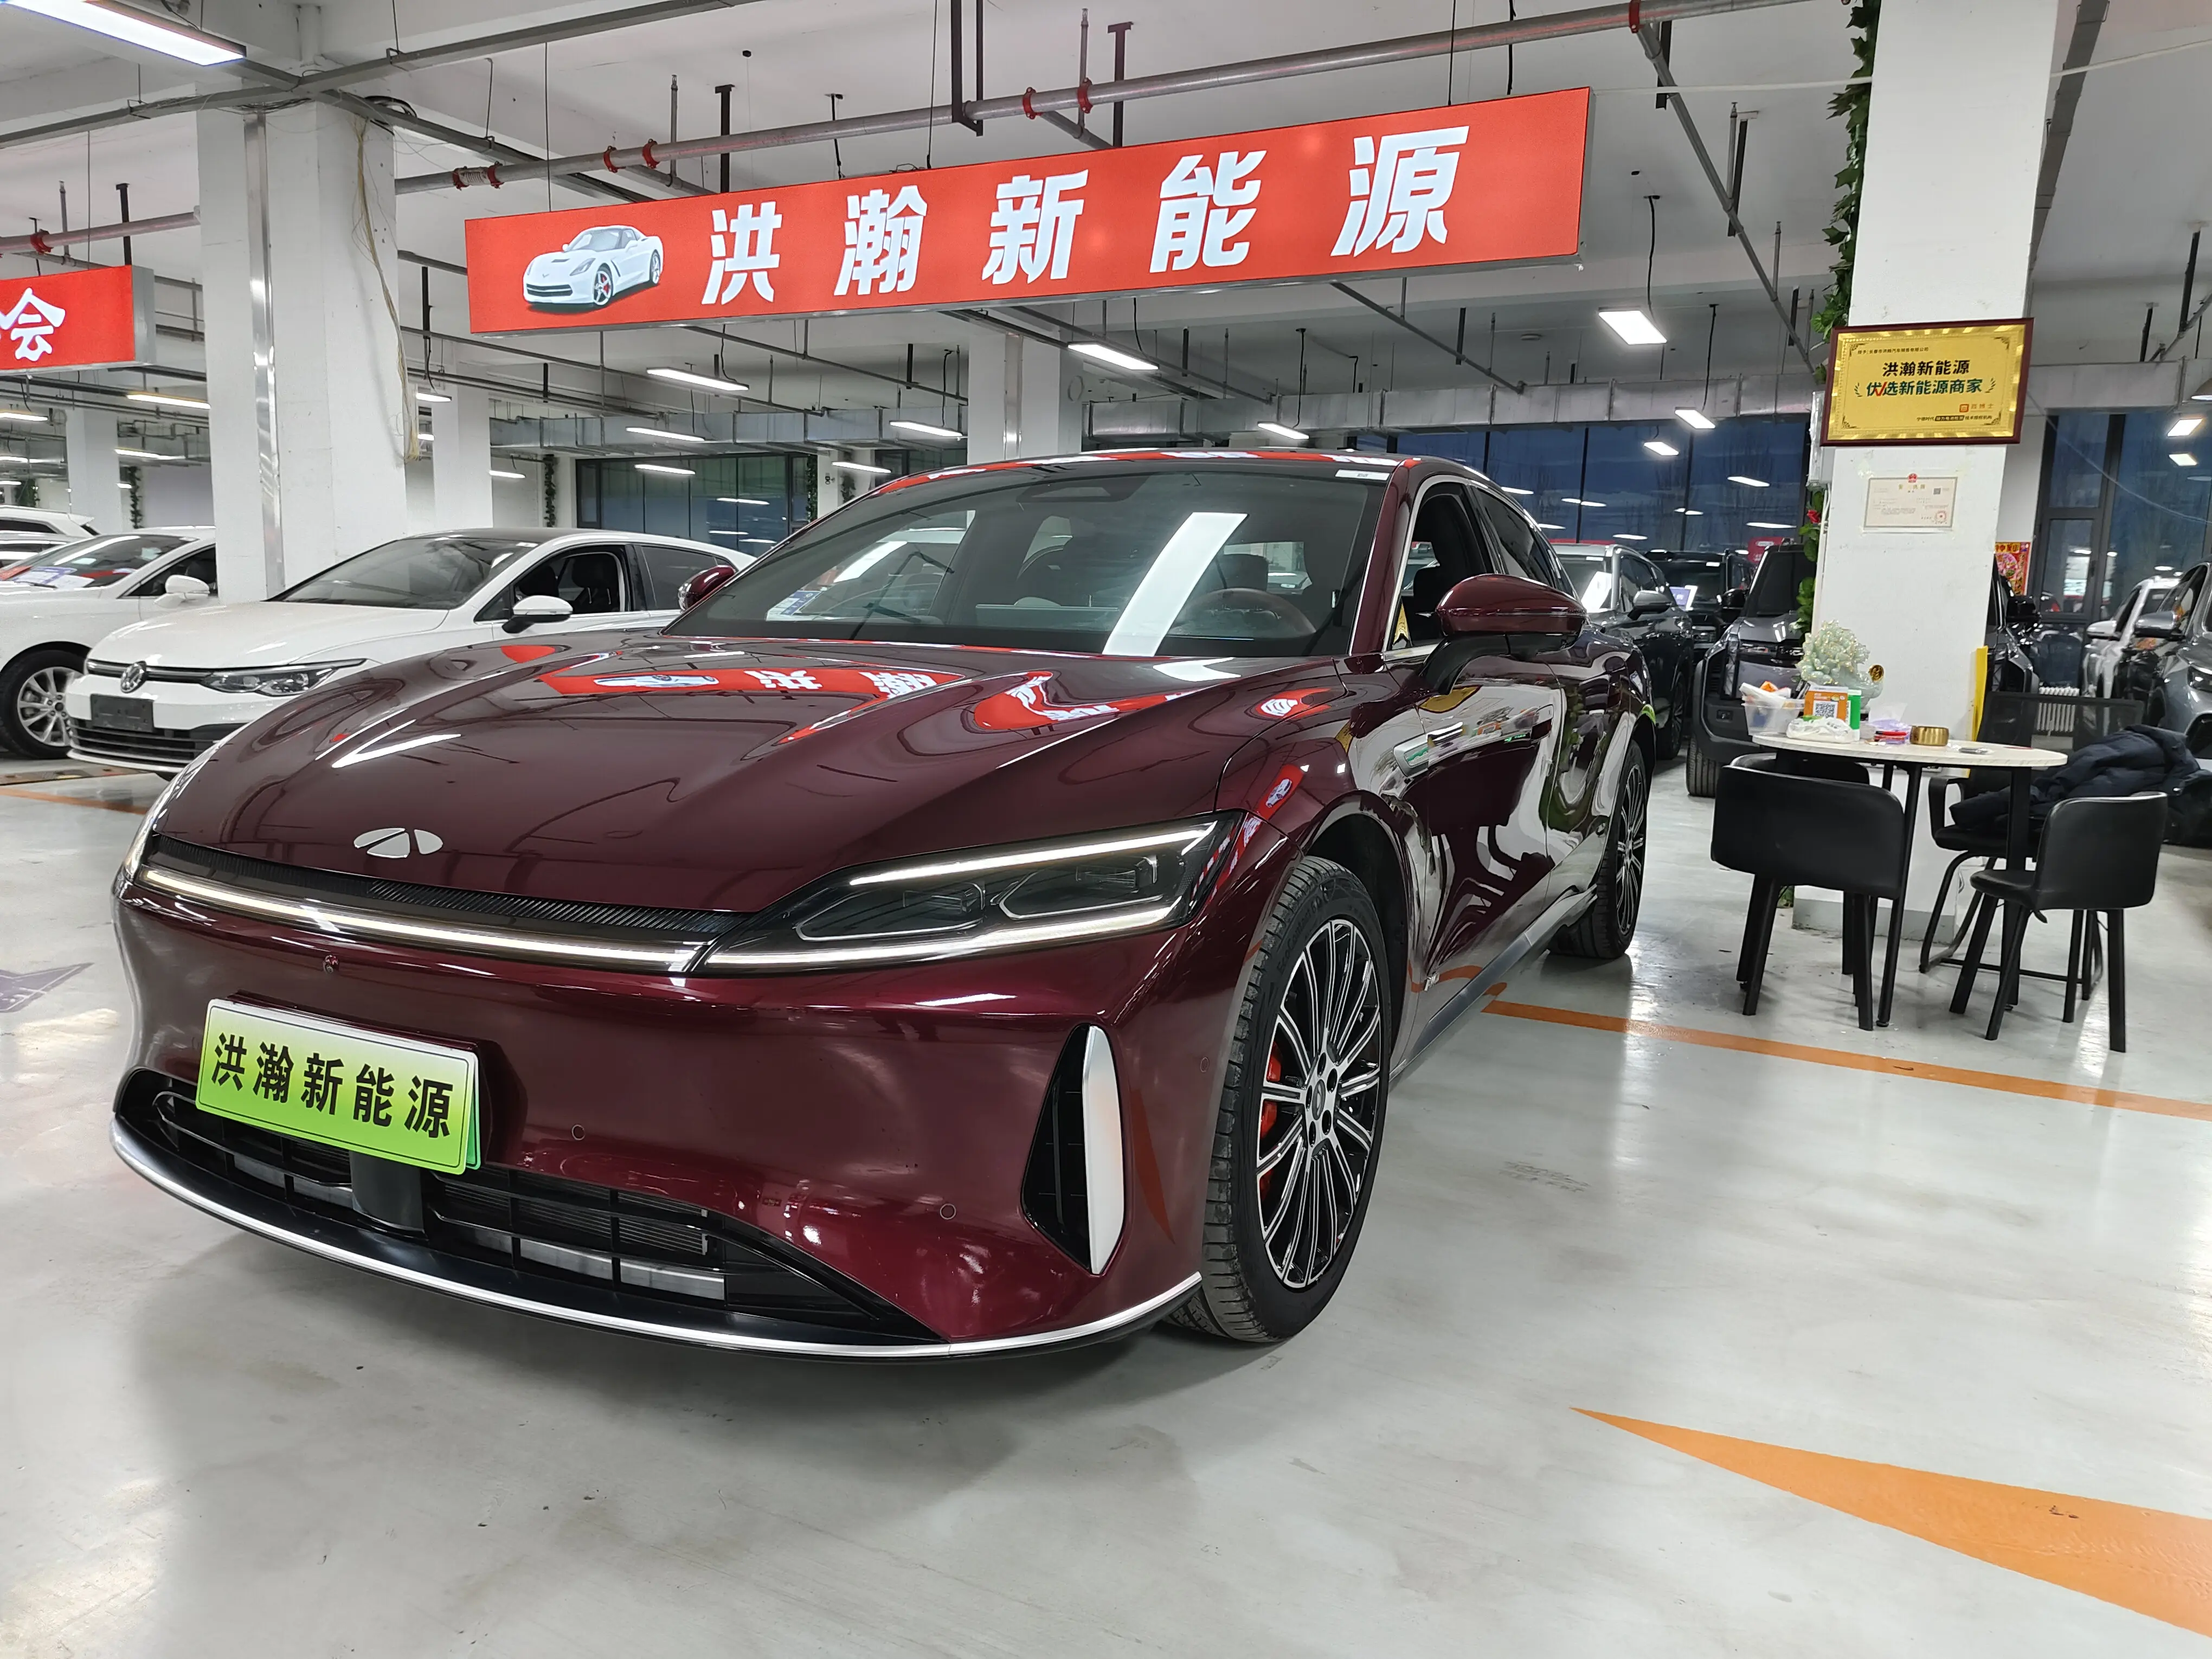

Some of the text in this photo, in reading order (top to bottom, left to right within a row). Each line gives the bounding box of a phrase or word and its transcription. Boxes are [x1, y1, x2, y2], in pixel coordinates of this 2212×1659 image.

[702, 126, 1469, 304] 洪瀚新能源
[1867, 378, 1983, 396] 优选新能源商家
[1882, 359, 1971, 377] 洪瀚新能源
[211, 1032, 453, 1138] 洪瀚新能源
